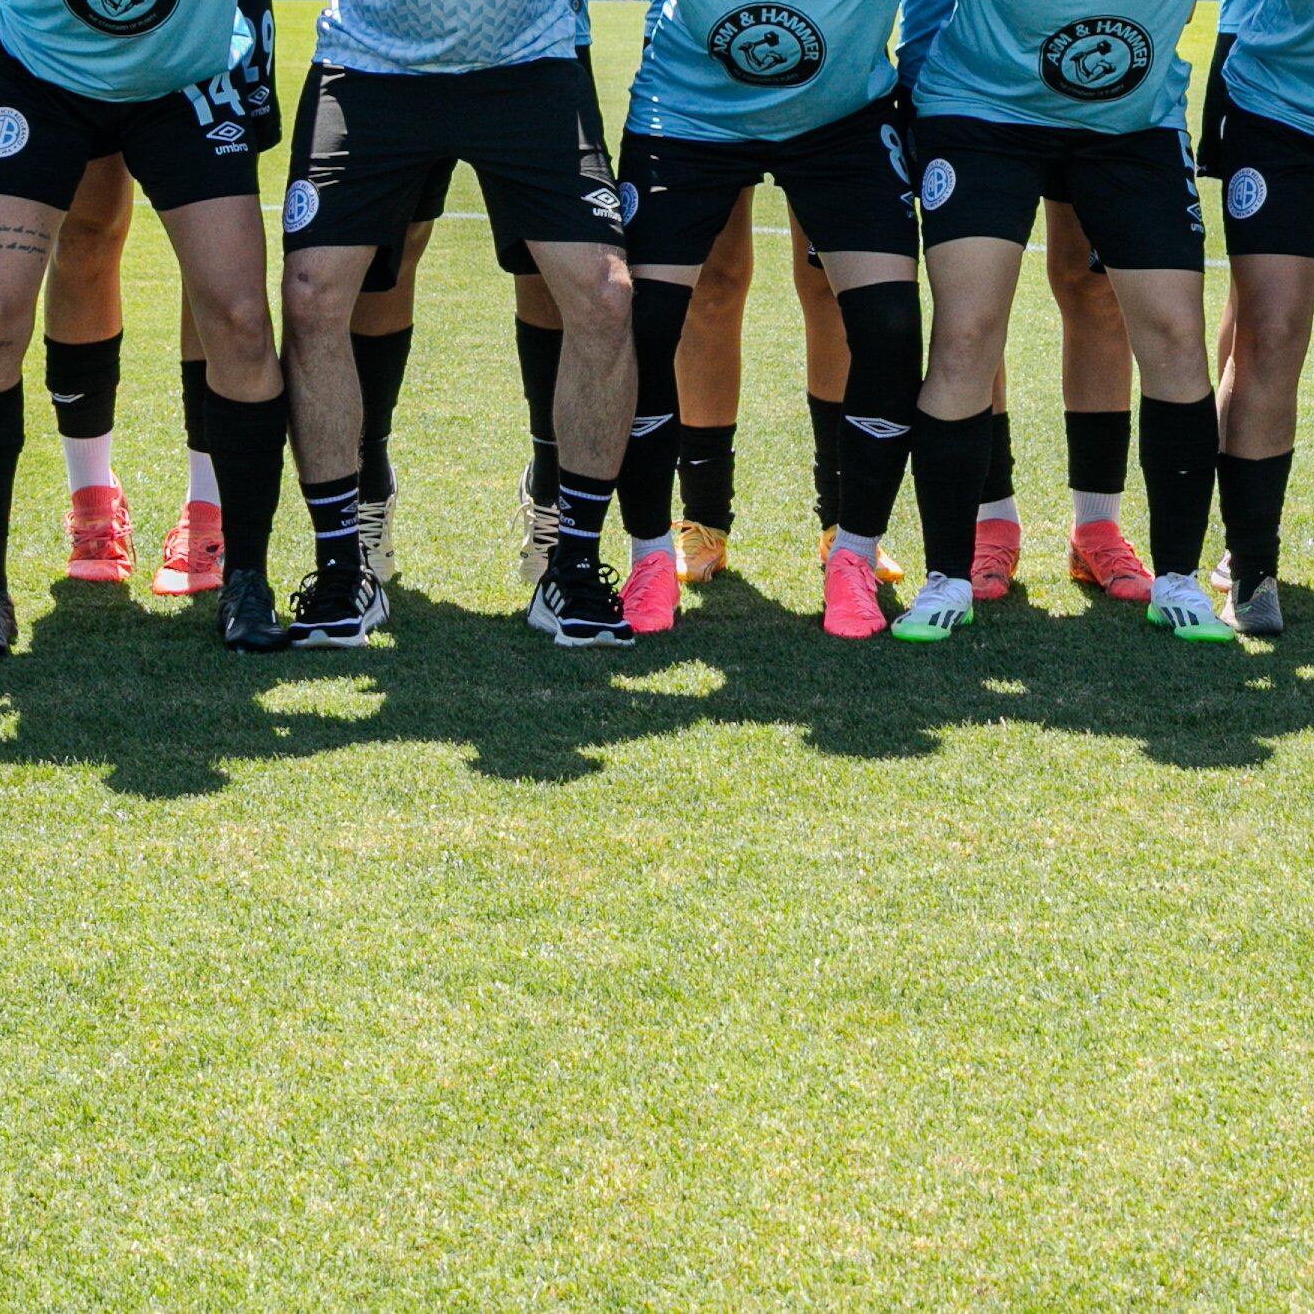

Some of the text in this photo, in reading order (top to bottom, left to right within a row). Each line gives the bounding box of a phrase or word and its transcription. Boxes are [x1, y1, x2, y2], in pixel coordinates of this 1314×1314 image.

[739, 11, 755, 25] &
[761, 8, 819, 61] HAMMER
[1075, 24, 1090, 37] &
[1095, 20, 1146, 68] HAMMER
[183, 72, 245, 126] 14
[215, 143, 249, 156] umbro
